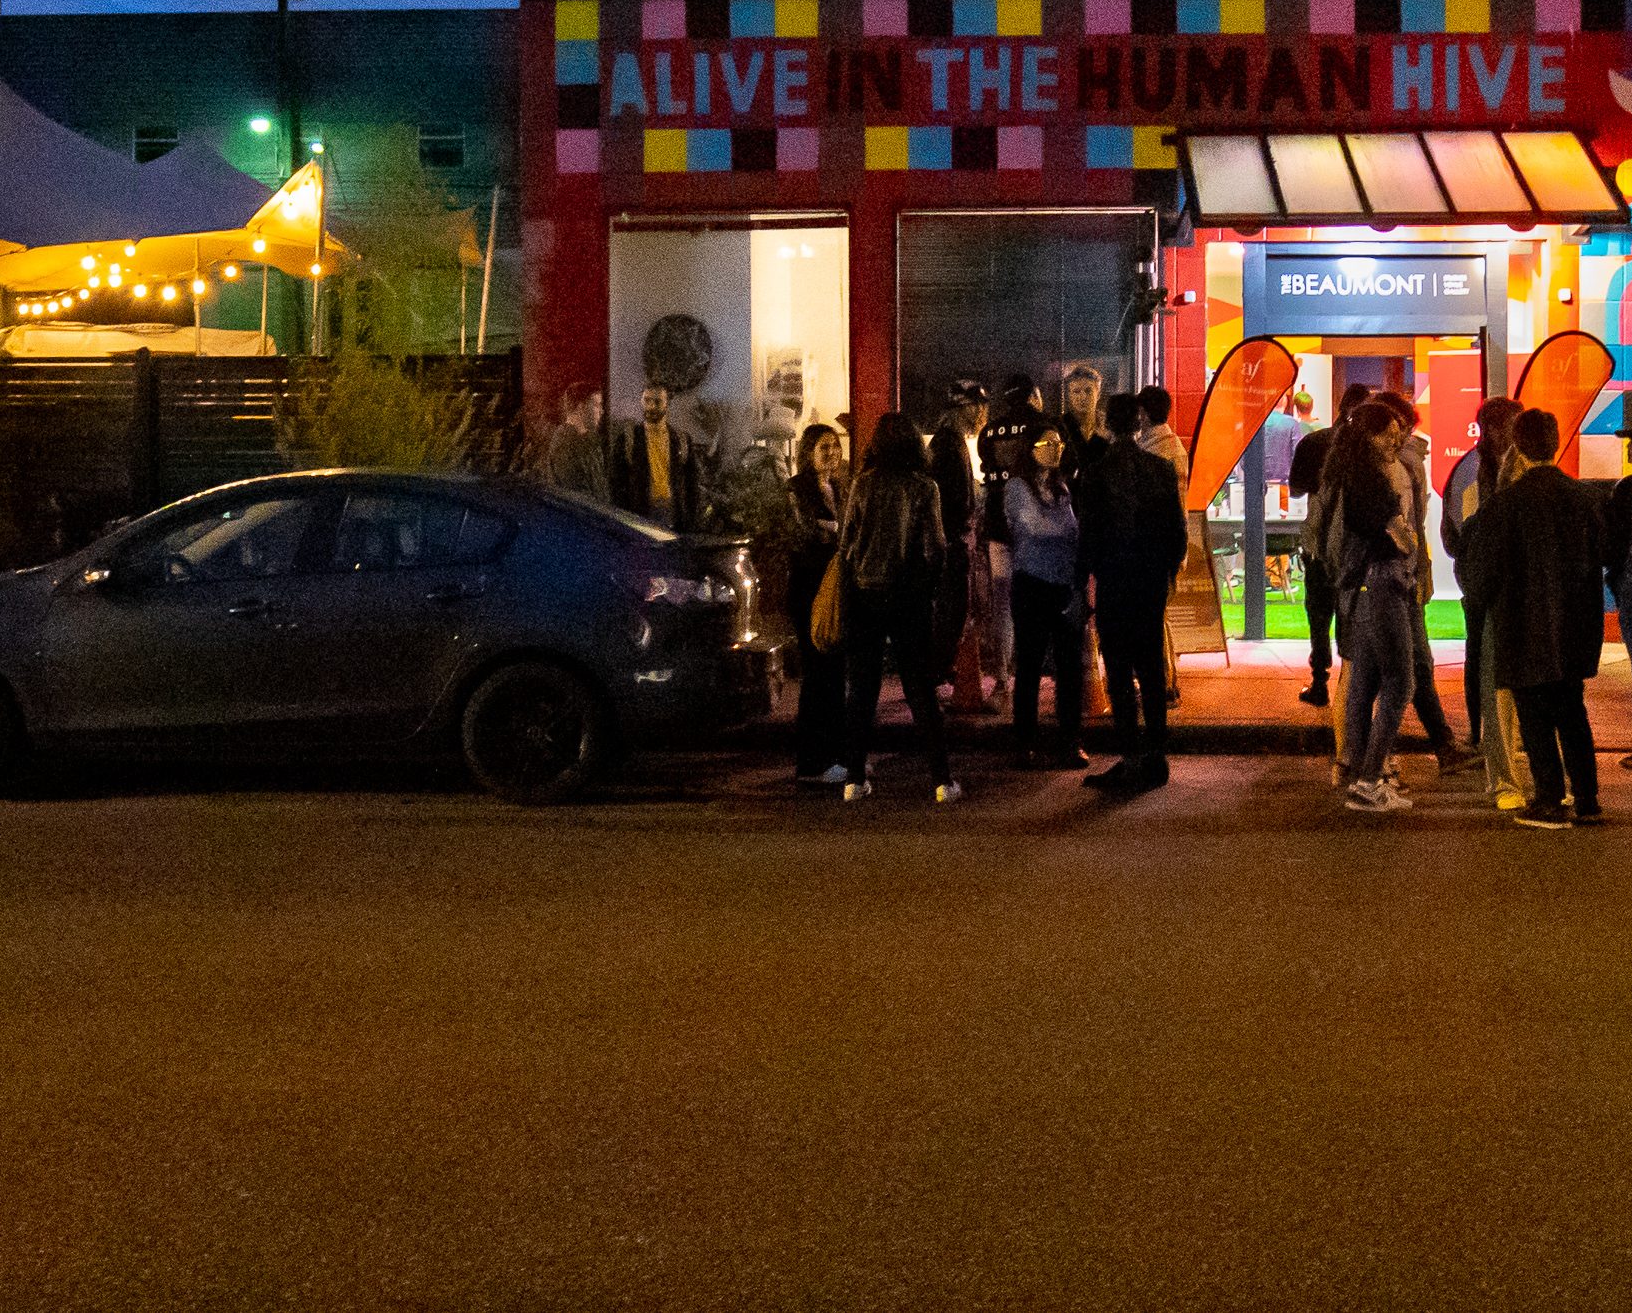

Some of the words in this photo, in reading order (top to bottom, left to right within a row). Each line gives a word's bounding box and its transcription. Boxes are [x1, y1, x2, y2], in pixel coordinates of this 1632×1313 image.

[610, 49, 808, 115] ALIVE
[826, 47, 901, 112] IN
[917, 45, 1058, 112] THE
[1077, 45, 1371, 112] HUMAN
[1393, 44, 1566, 112] HIVE
[1292, 273, 1426, 296] BEAUMONT
